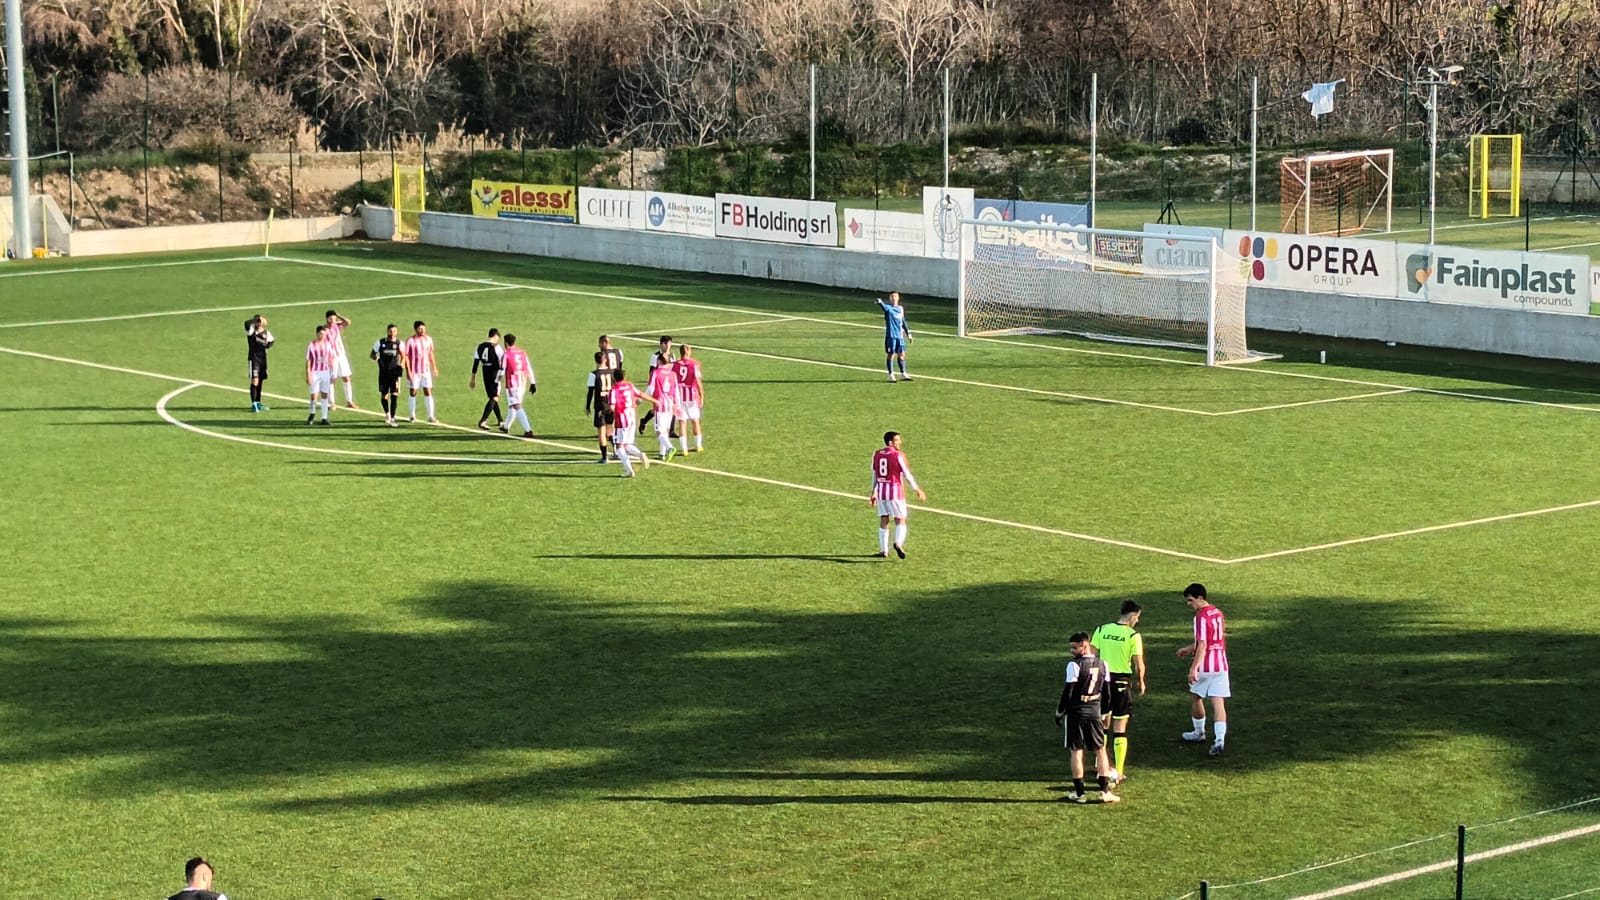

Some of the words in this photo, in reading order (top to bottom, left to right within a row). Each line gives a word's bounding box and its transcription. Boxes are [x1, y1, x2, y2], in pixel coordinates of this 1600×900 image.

[501, 185, 572, 209] alessi
[1288, 243, 1379, 277] OPERA
[1313, 274, 1352, 287] GROUP
[1437, 257, 1576, 299] Fainplast
[1513, 293, 1573, 307] compounds
[482, 347, 489, 362] 4
[600, 373, 612, 391] 11
[679, 366, 688, 382] 9
[879, 458, 888, 476] 8
[1211, 616, 1223, 641] 11
[1102, 634, 1126, 642] LEGEA
[1088, 667, 1099, 694] 7
